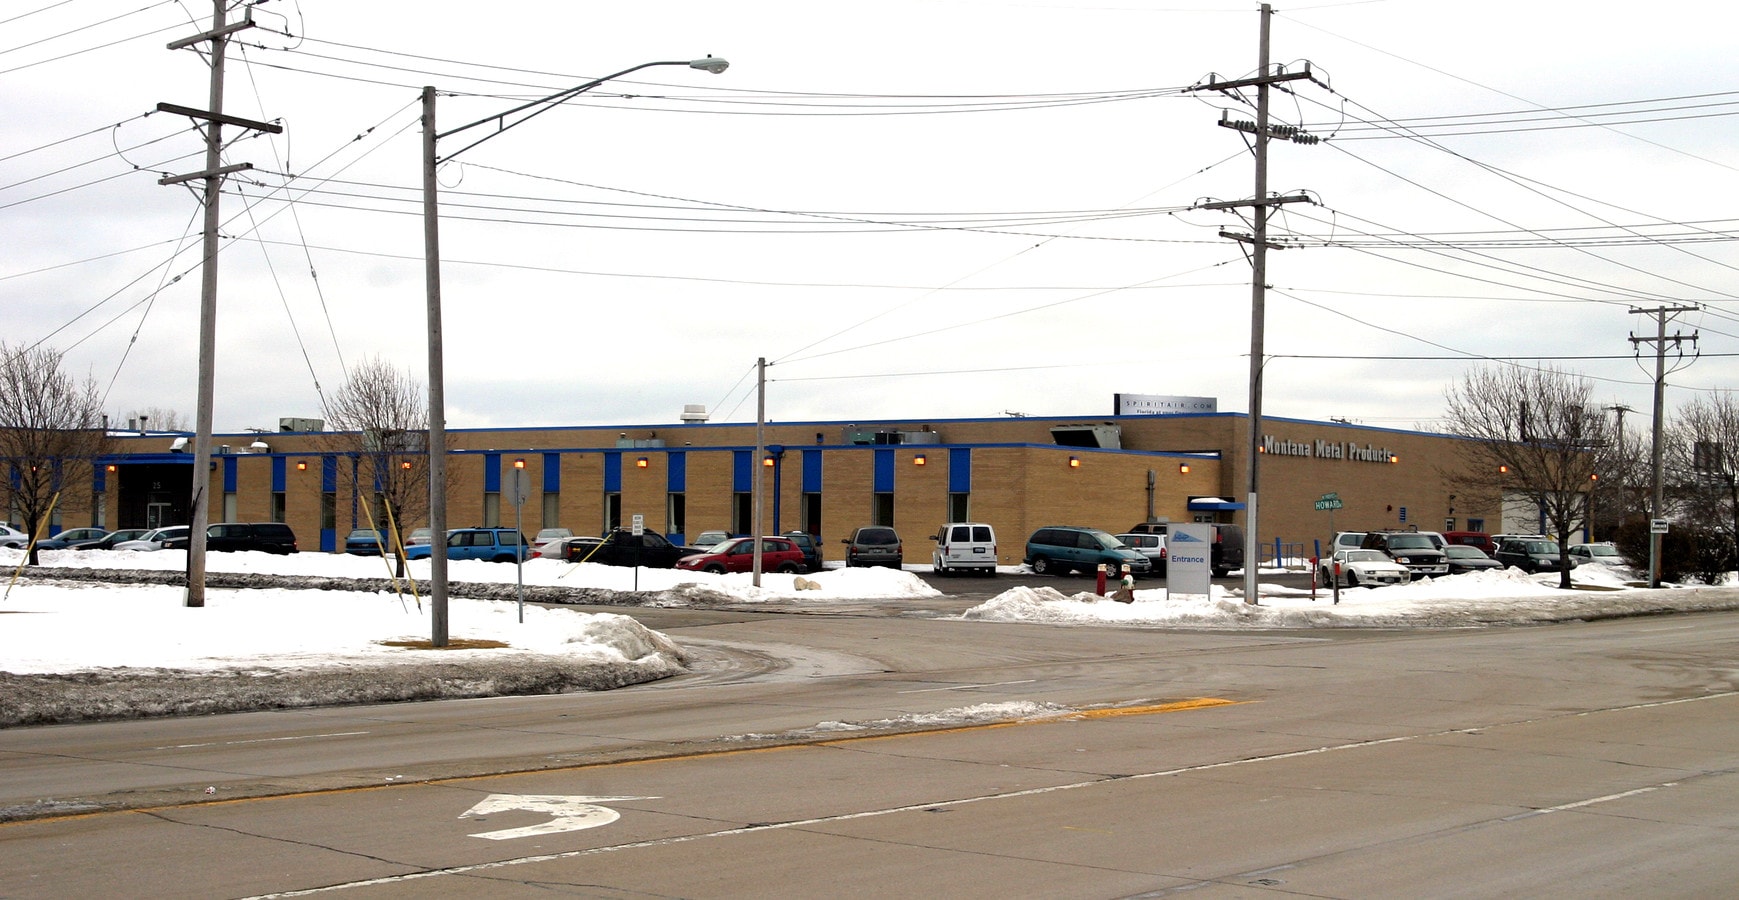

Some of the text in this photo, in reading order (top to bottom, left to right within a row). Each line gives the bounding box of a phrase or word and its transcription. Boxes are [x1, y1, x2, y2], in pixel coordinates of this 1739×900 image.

[1126, 400, 1212, 409] SPIRITAIR.COM
[1263, 434, 1392, 462] Montana Metal Products
[1315, 499, 1338, 510] HOWARD
[1171, 555, 1204, 563] Entrance
